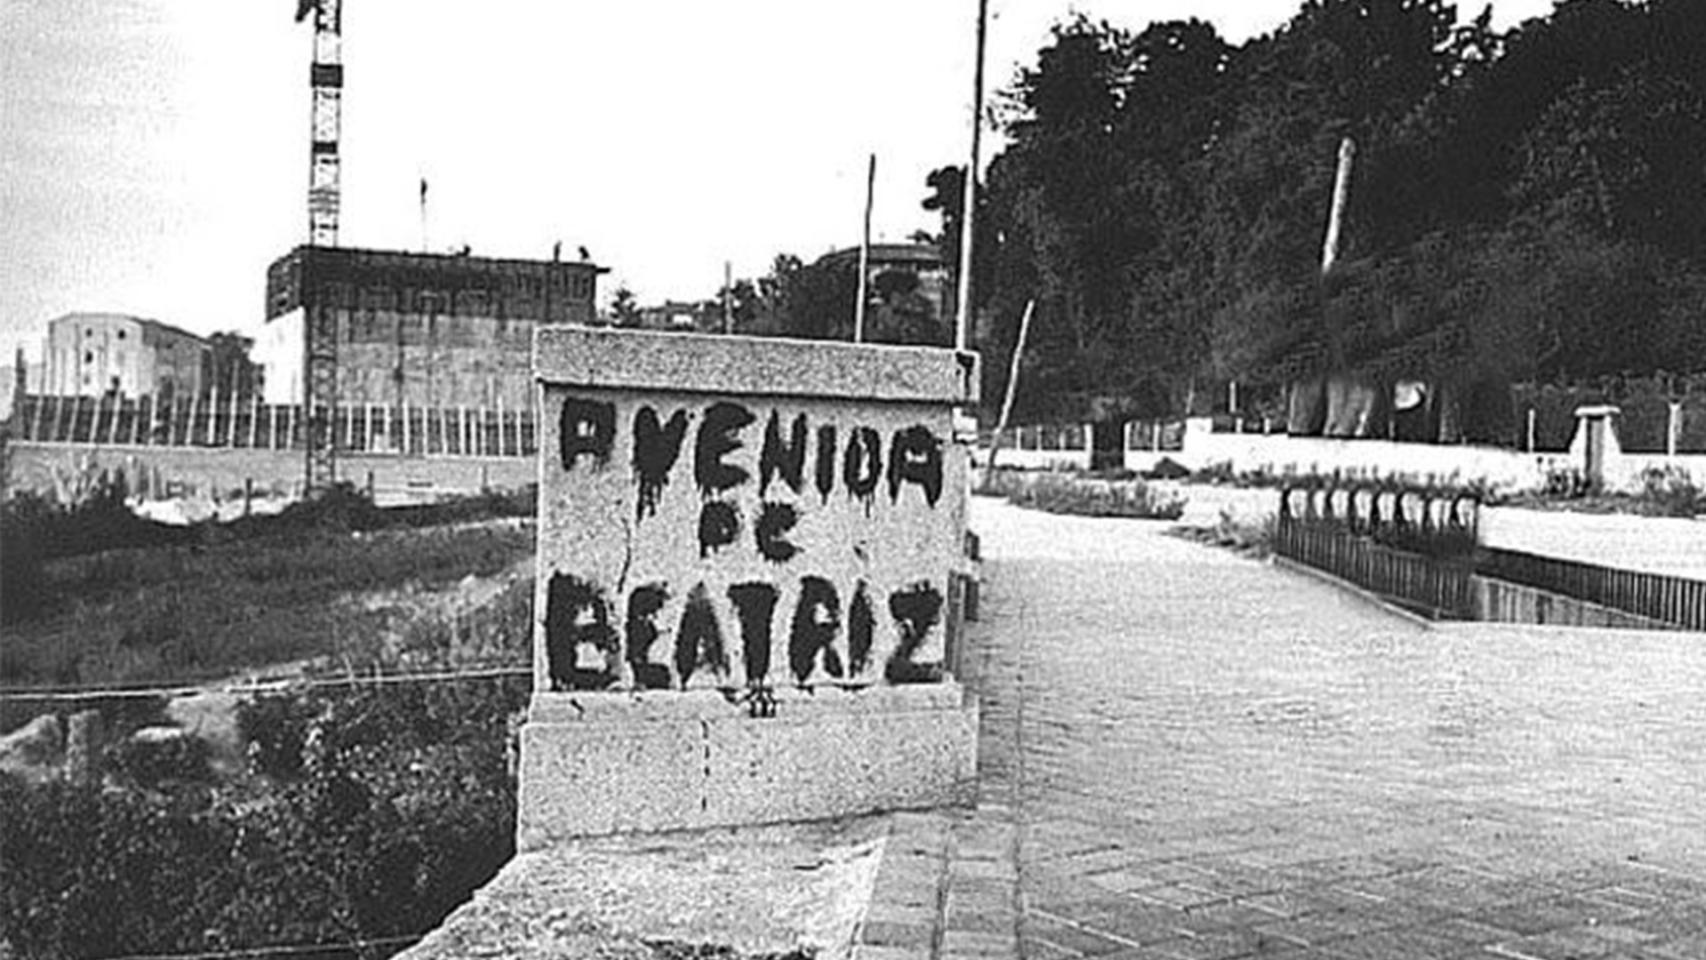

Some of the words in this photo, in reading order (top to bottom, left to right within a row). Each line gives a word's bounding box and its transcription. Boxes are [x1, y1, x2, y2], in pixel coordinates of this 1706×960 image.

[559, 399, 944, 510] AVENIDA
[698, 501, 803, 562] DE
[545, 570, 945, 691] BEATRIZ
